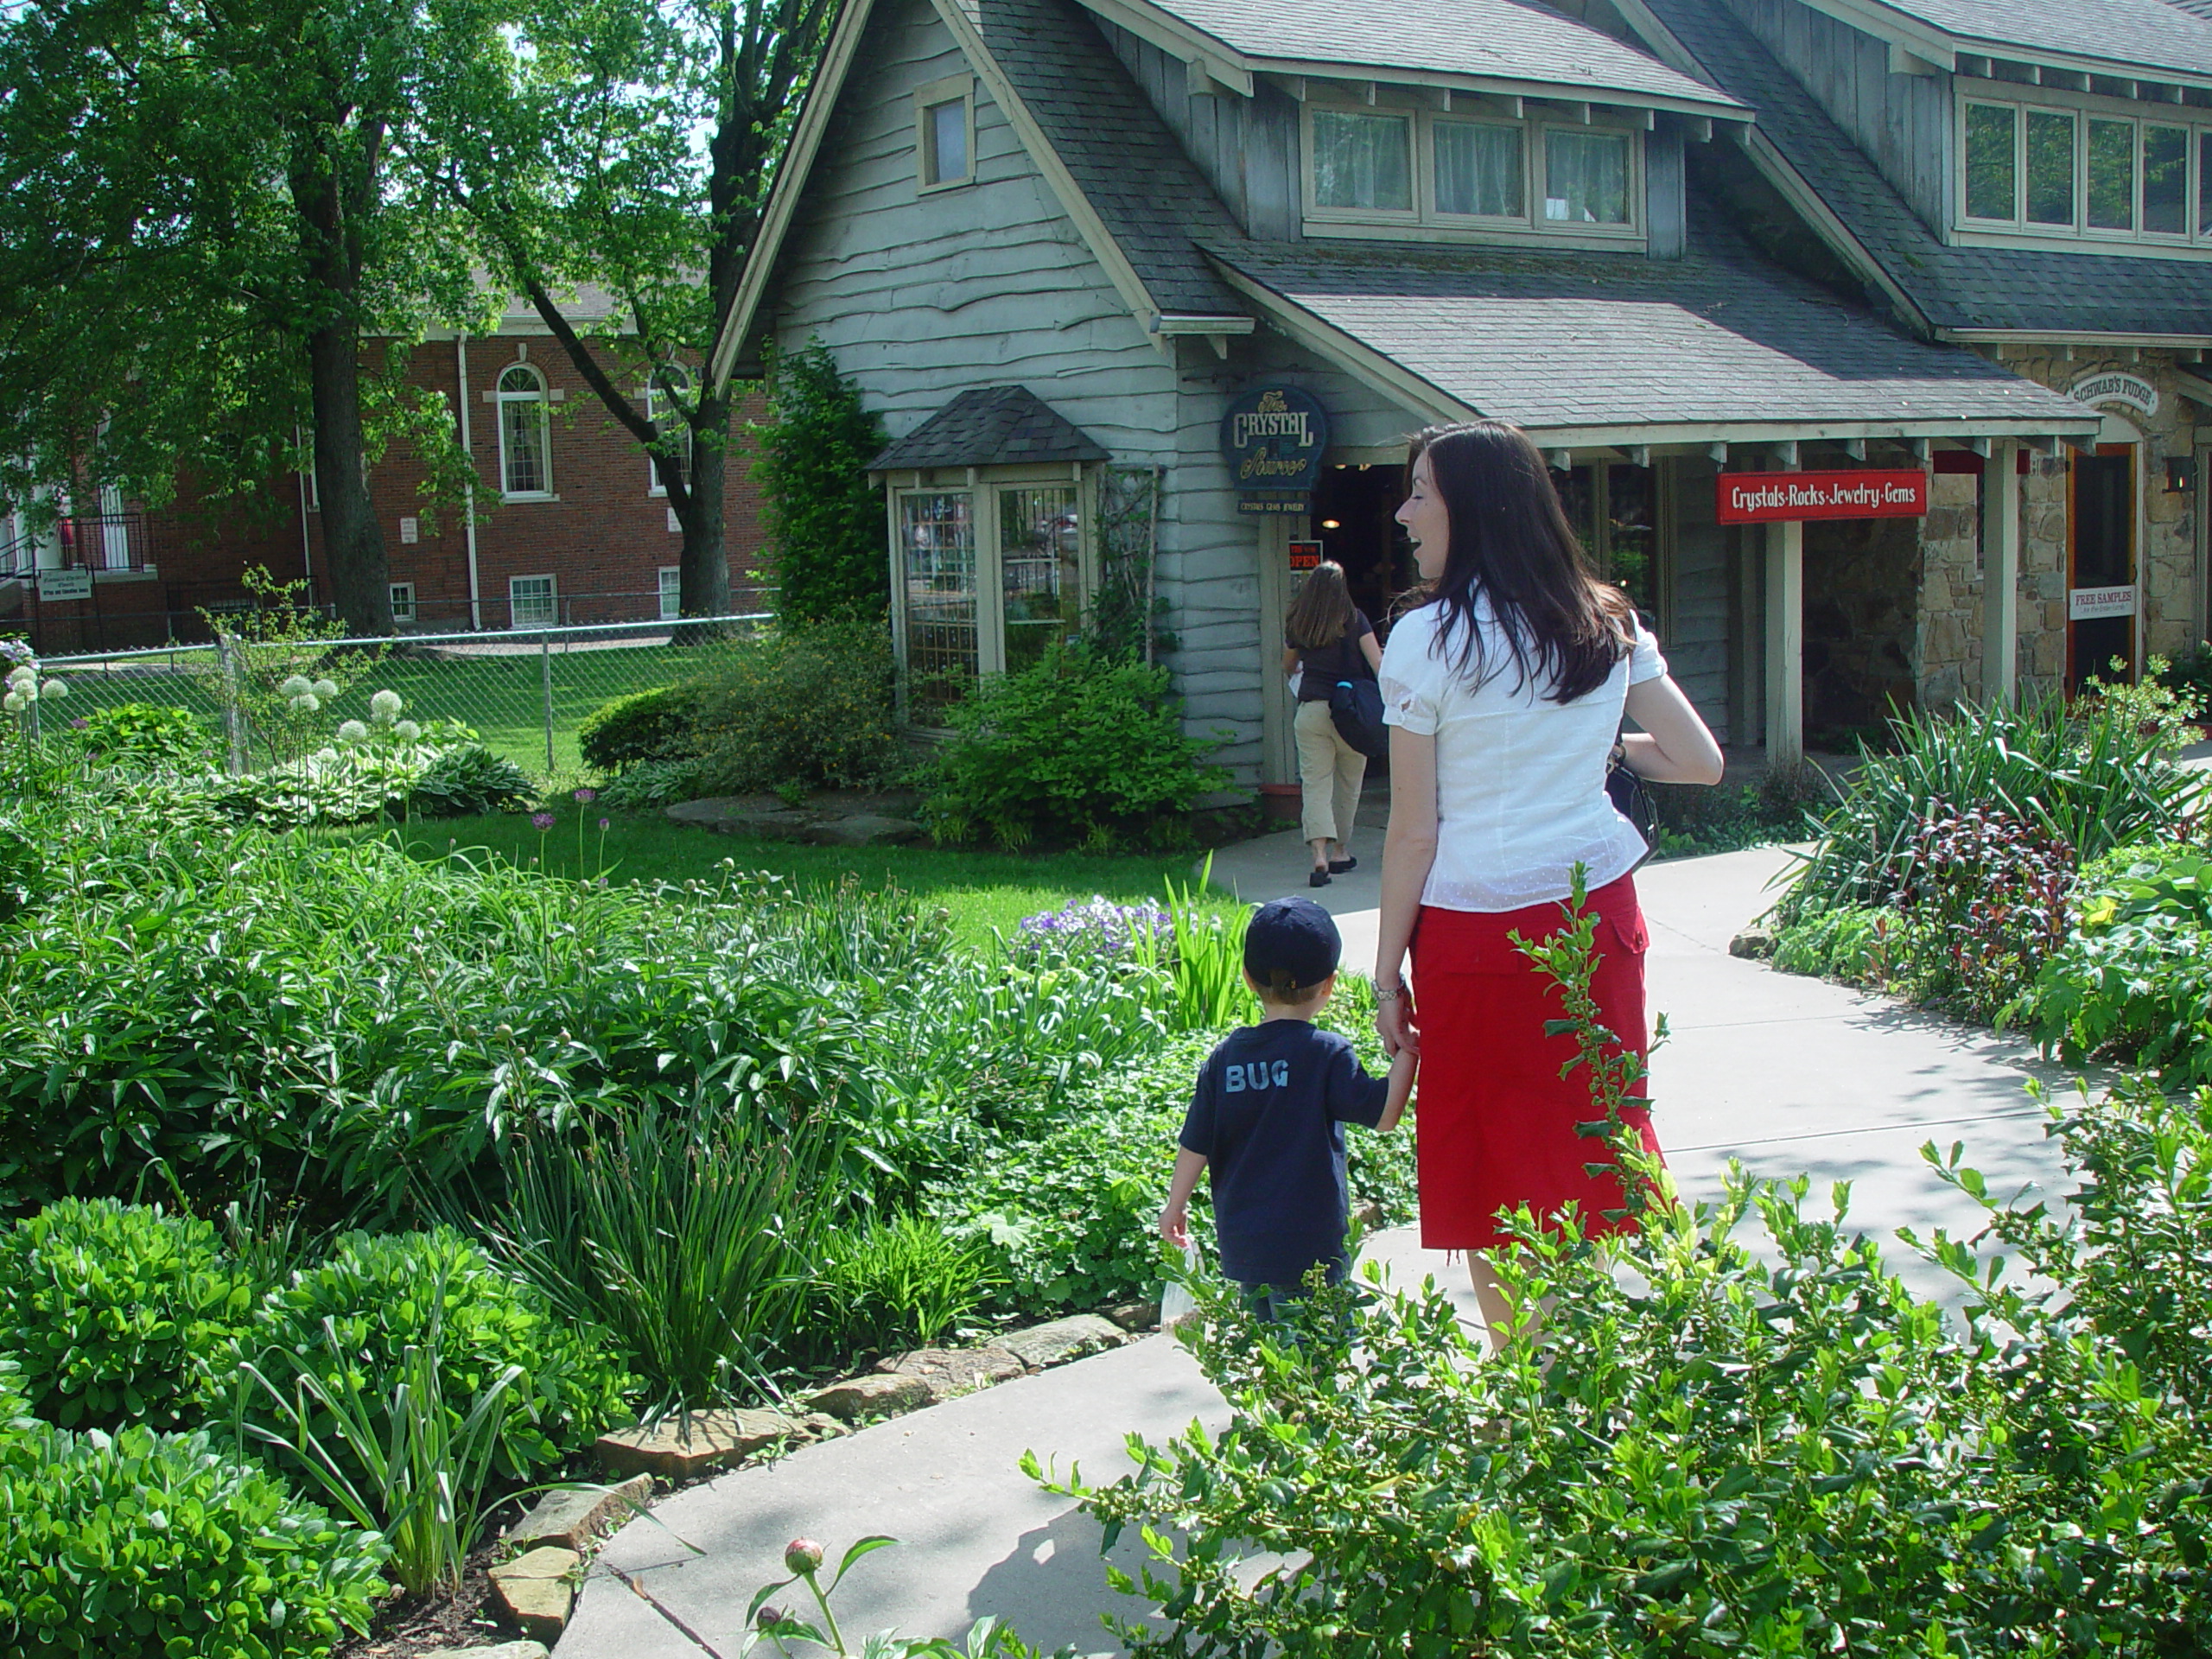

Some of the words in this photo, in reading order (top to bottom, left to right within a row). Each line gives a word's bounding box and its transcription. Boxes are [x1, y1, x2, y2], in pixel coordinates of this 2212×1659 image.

[2074, 376, 2121, 403] SCHWAB'S
[2122, 379, 2152, 406] FUDGE
[1234, 411, 1314, 448] CRYSTAL
[1732, 485, 1786, 512] Crystals
[1789, 483, 1826, 506] Rocks
[1828, 482, 1879, 509] Jewelry
[1885, 481, 1916, 503] Gems
[2075, 594, 2096, 606] FREE
[2097, 591, 2132, 604] SAMPLES
[1226, 1059, 1289, 1092] BUG
